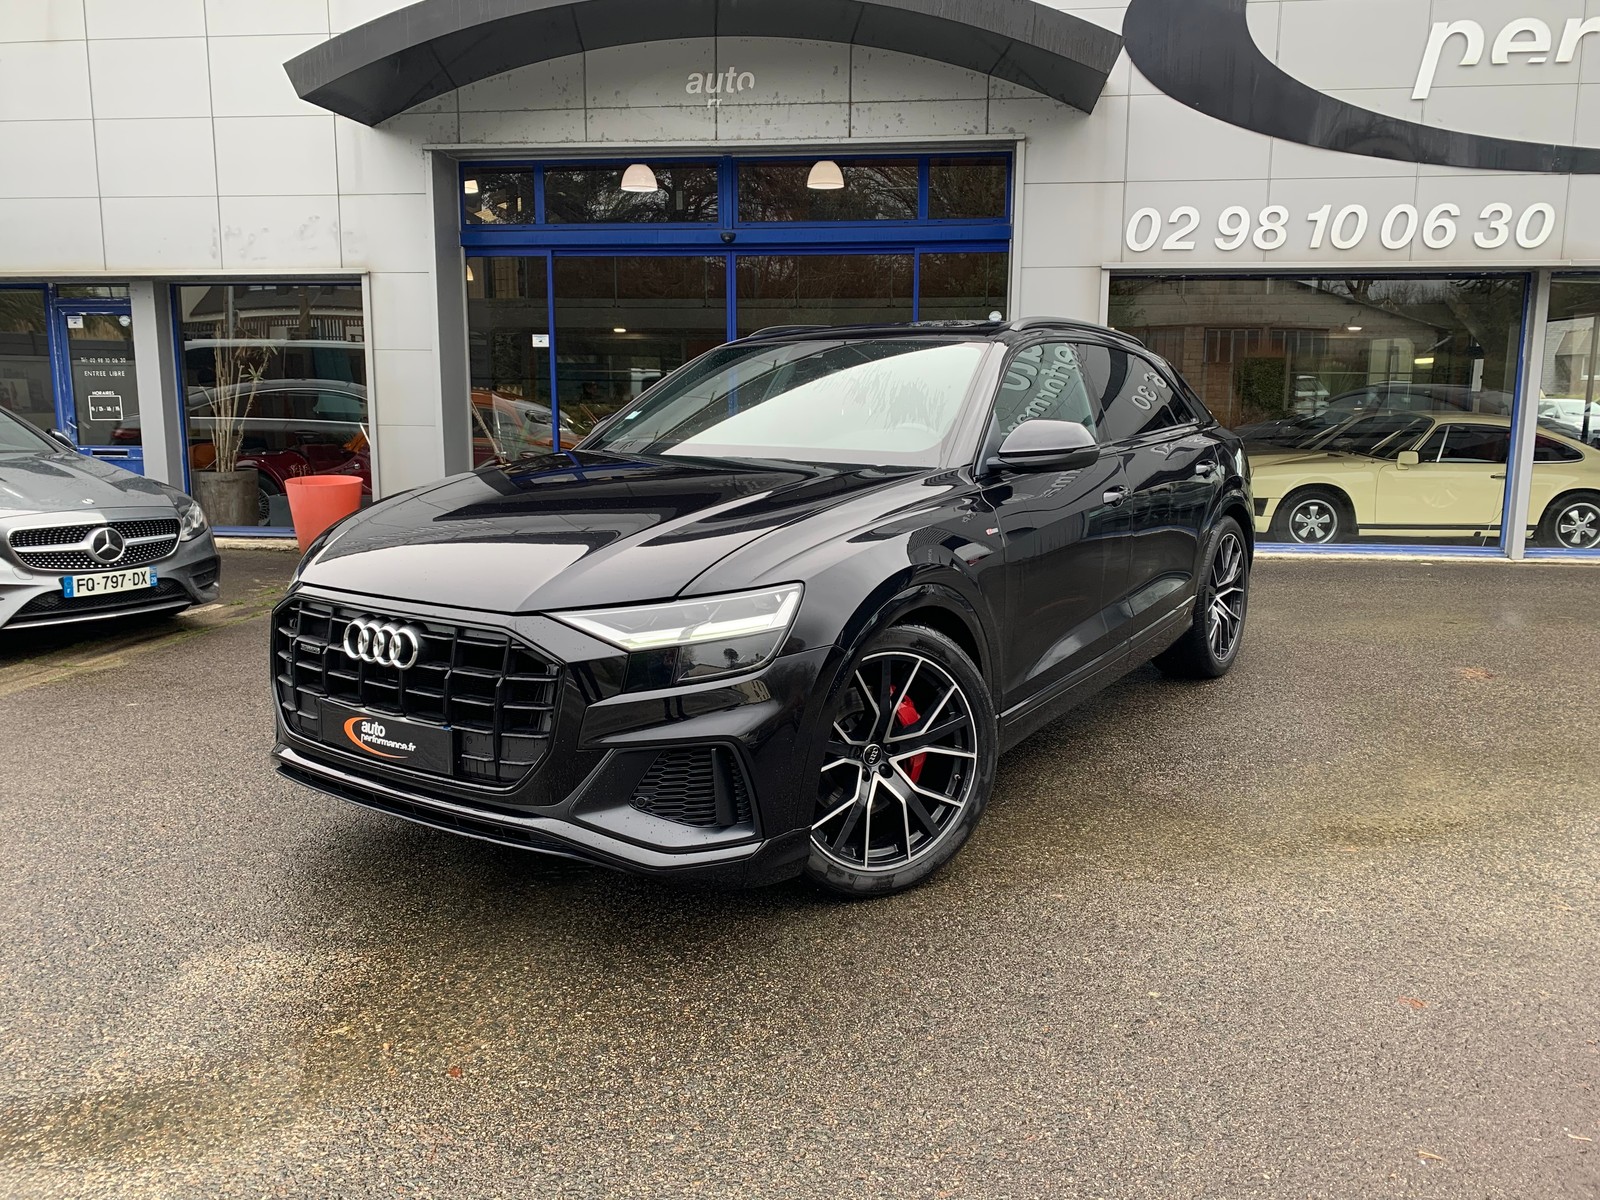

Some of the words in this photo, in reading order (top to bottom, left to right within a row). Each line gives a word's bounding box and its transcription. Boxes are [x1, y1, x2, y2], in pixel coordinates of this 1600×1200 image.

[685, 66, 755, 94] auto
[1125, 205, 1200, 252] 02
[1214, 204, 1290, 251] 98
[1306, 203, 1369, 250] 10
[1380, 202, 1461, 250] 06
[1473, 202, 1556, 249] 30
[76, 571, 147, 593] FQ-797-DX
[361, 721, 386, 737] auto
[361, 733, 416, 752] performance.fr
